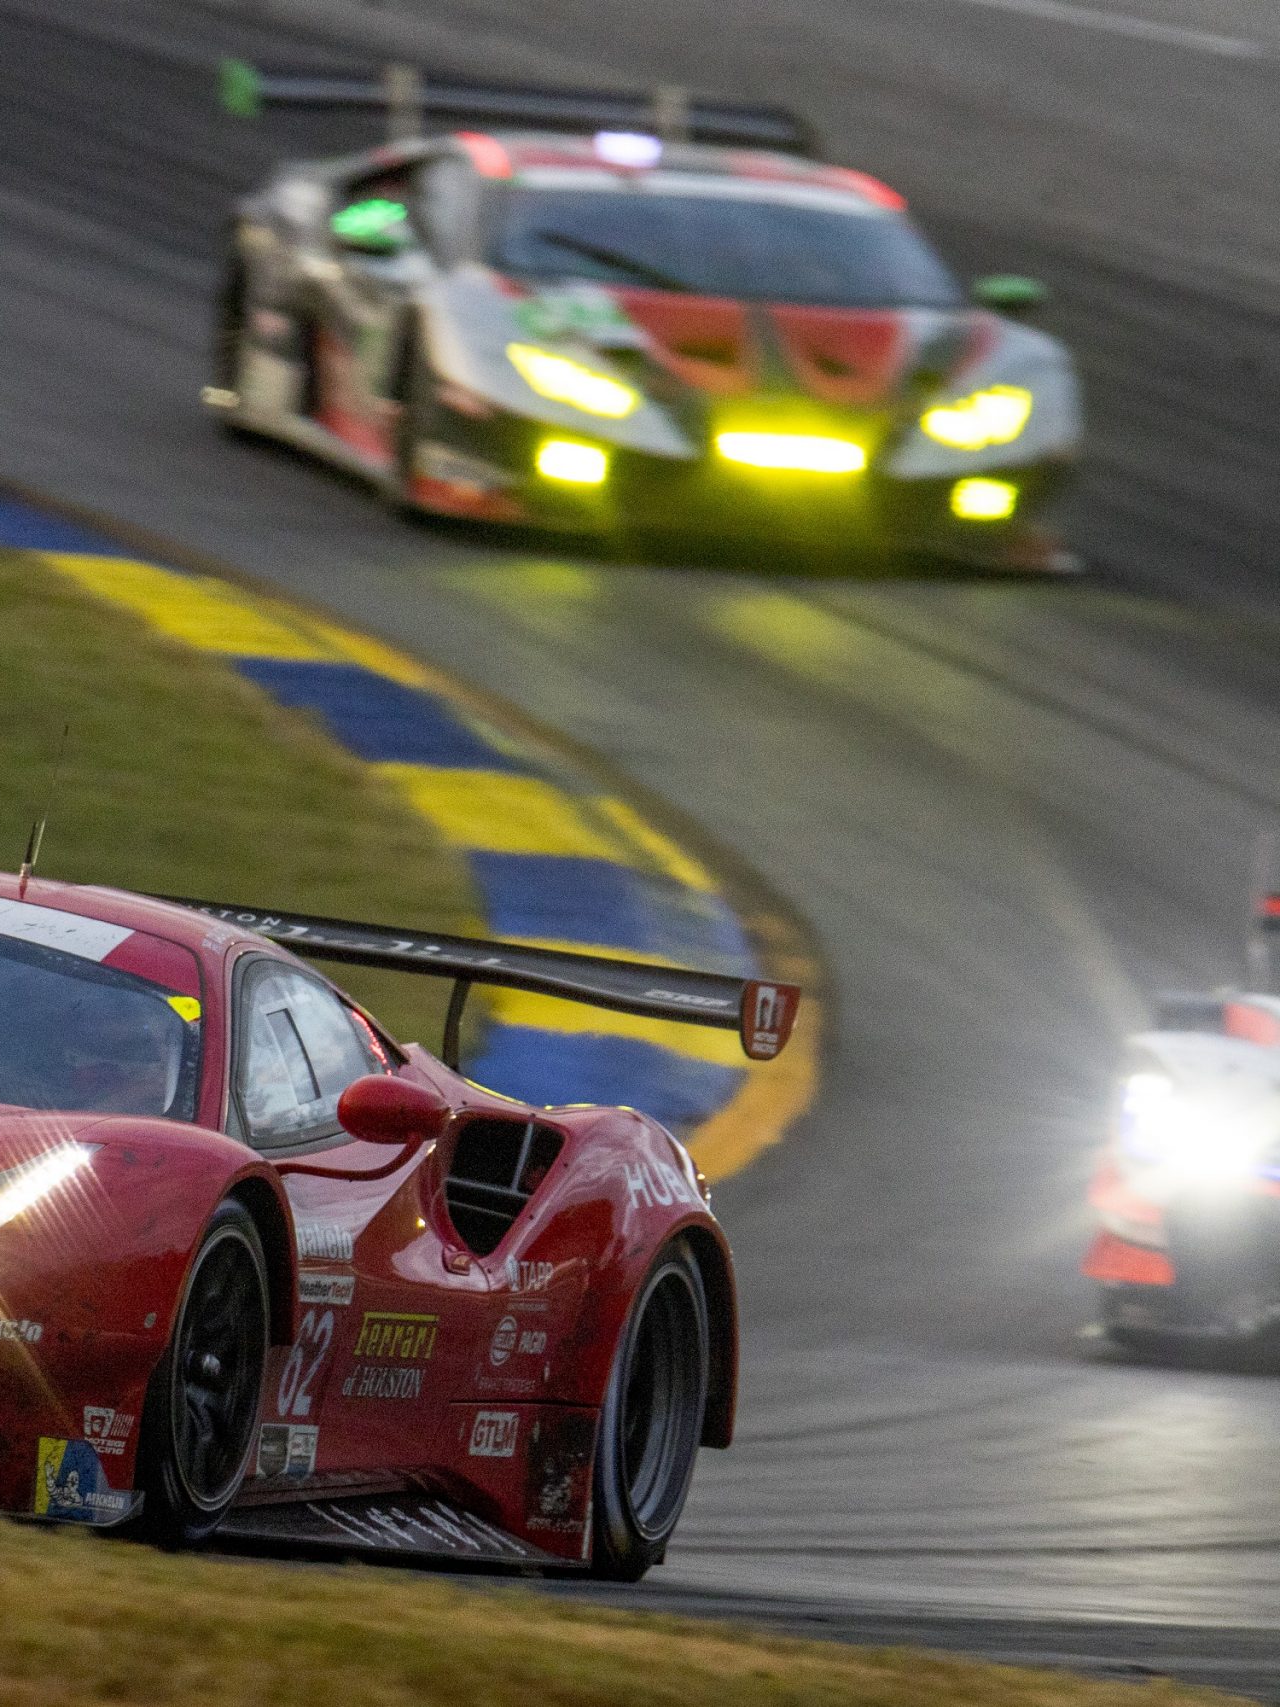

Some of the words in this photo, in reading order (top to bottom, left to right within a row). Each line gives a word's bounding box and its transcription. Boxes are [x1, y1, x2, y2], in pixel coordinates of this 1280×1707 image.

[354, 1312, 440, 1359] Ferrari
[278, 1310, 334, 1416] 62
[342, 1364, 360, 1397] of
[357, 1366, 426, 1399] HOUSTON
